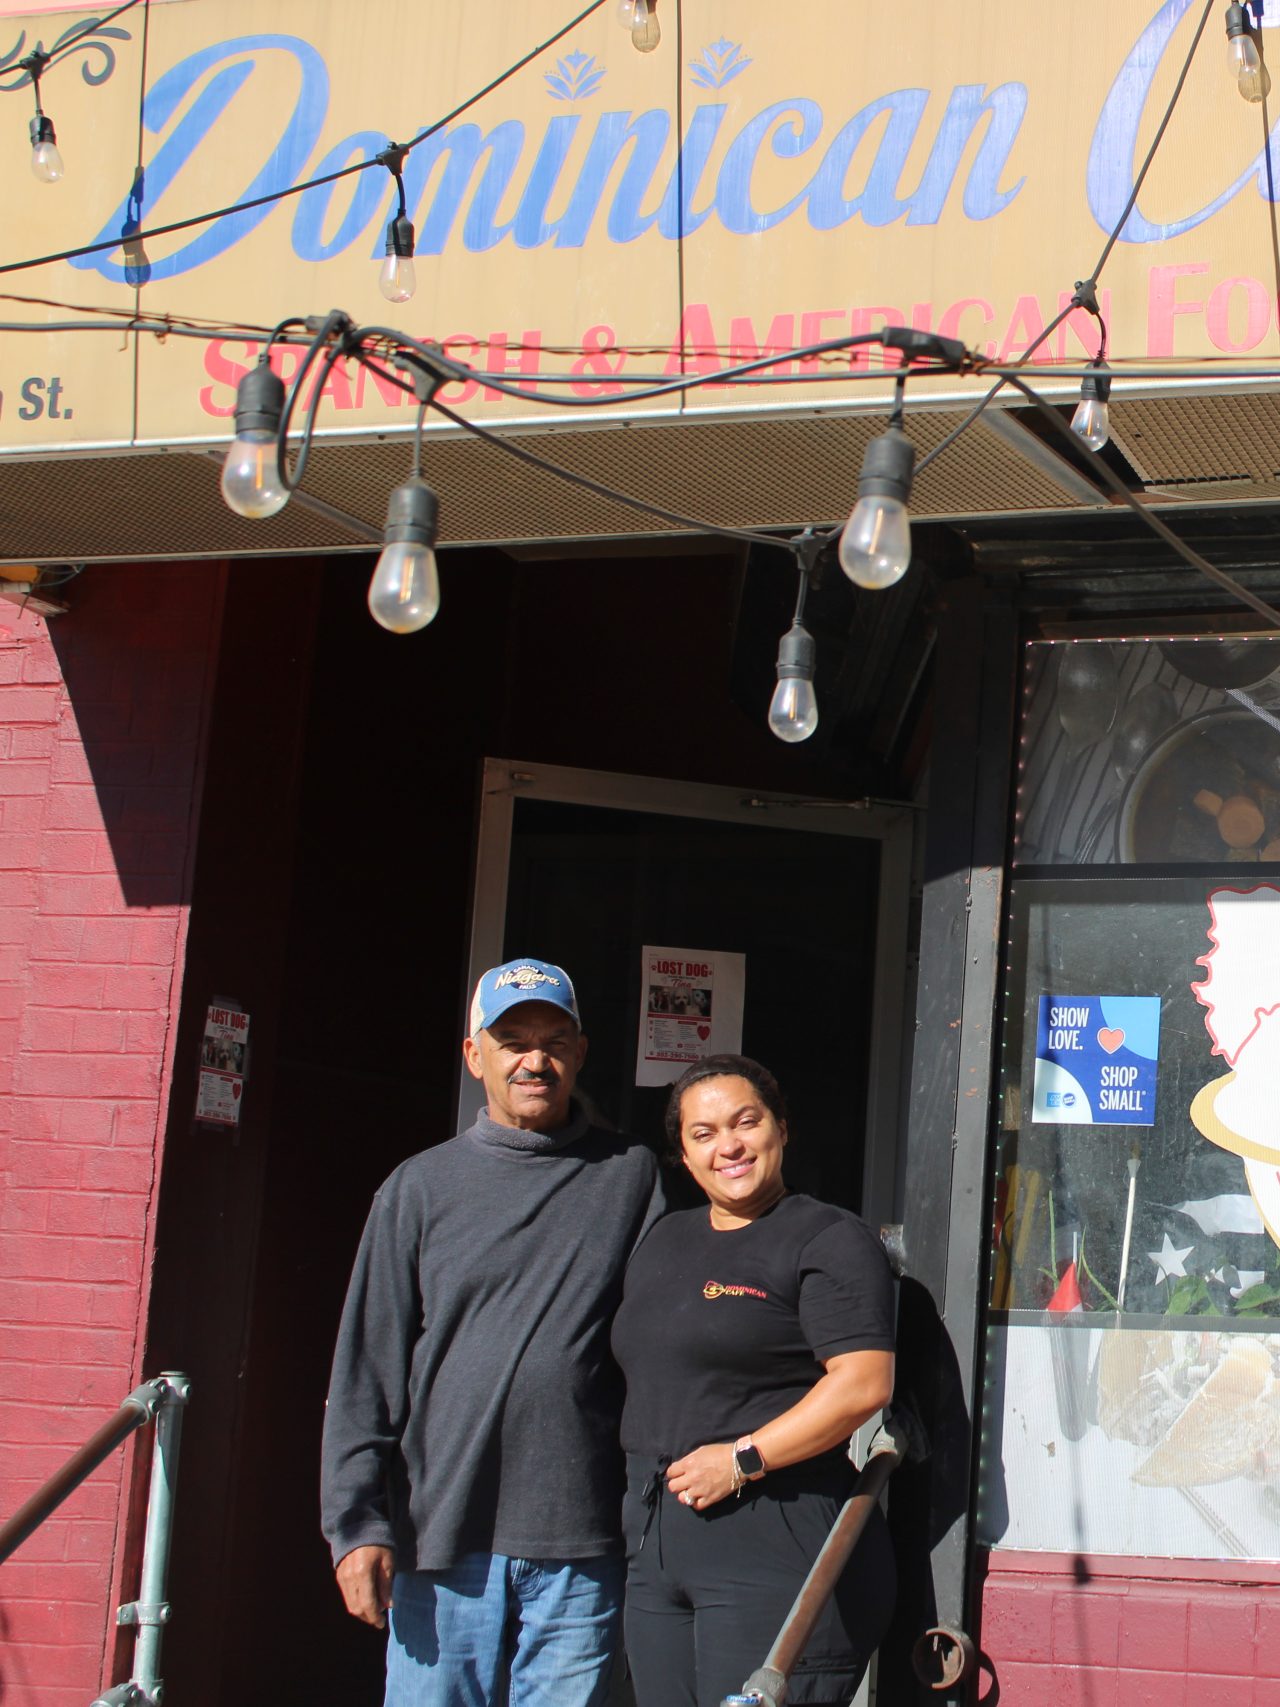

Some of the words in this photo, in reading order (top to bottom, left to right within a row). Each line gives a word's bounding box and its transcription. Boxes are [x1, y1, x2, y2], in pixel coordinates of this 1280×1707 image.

[68, 34, 1027, 284] Dominican
[566, 325, 628, 398] &
[18, 377, 73, 421] St.
[657, 961, 683, 975] LOST
[686, 963, 709, 977] DOG
[494, 971, 560, 991] Niagara
[211, 1007, 230, 1026] LOST
[231, 1010, 246, 1030] DOG
[1050, 1007, 1090, 1028] SHOW
[1048, 1030, 1084, 1051] LOVE.
[1100, 1066, 1138, 1087] SHOP
[725, 1285, 767, 1299] DOMINICAN
